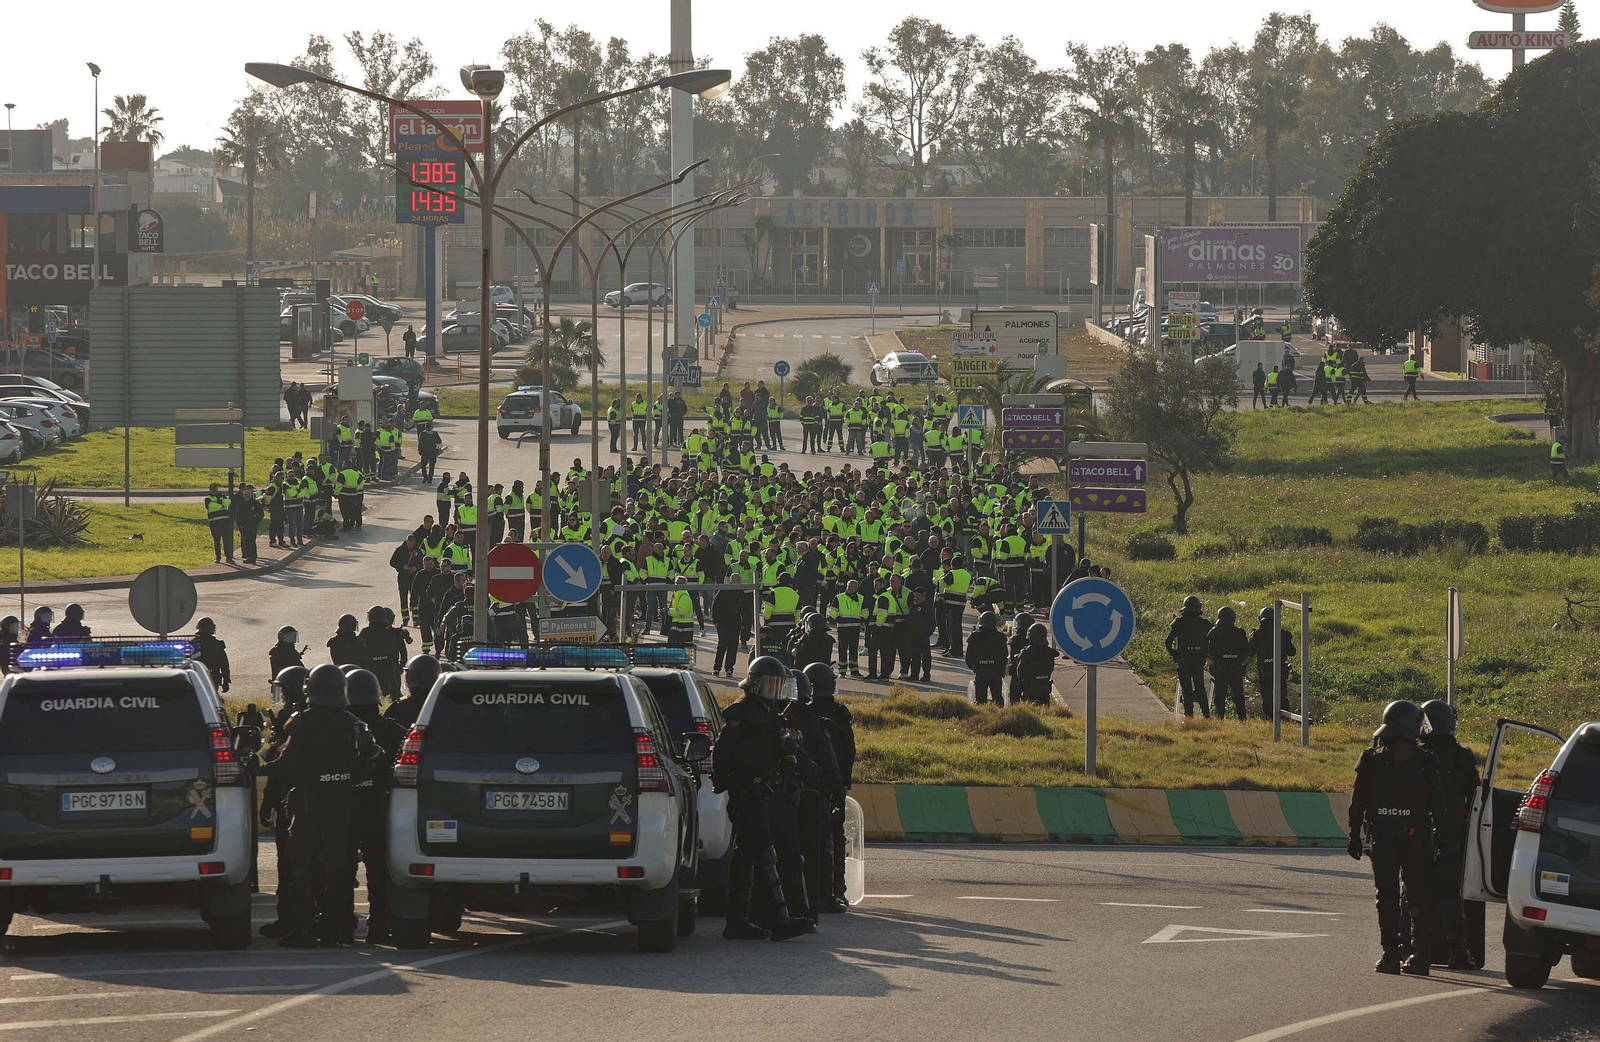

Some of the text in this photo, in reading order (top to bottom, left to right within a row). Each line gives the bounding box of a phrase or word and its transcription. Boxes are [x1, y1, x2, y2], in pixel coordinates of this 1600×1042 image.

[1476, 34, 1564, 47] AUTO KING
[399, 119, 415, 135] el
[398, 142, 435, 151] Plenoil
[785, 203, 914, 224] ACERINOX
[1188, 240, 1265, 261] dimas
[1188, 262, 1264, 270] PALMONES
[1272, 256, 1294, 271] 30
[5, 264, 114, 280] TACO BELL
[1169, 316, 1192, 324] TANGER
[1169, 330, 1191, 338] CEUTA
[953, 361, 987, 371] TANGER
[1081, 468, 1131, 476] TACO BELL
[551, 622, 588, 631] Palmones
[560, 633, 596, 643] comercial
[40, 696, 160, 711] GUARDIA CIVIL
[472, 693, 590, 706] GUARDIA CIVIL
[1377, 808, 1411, 816] 2G1C110
